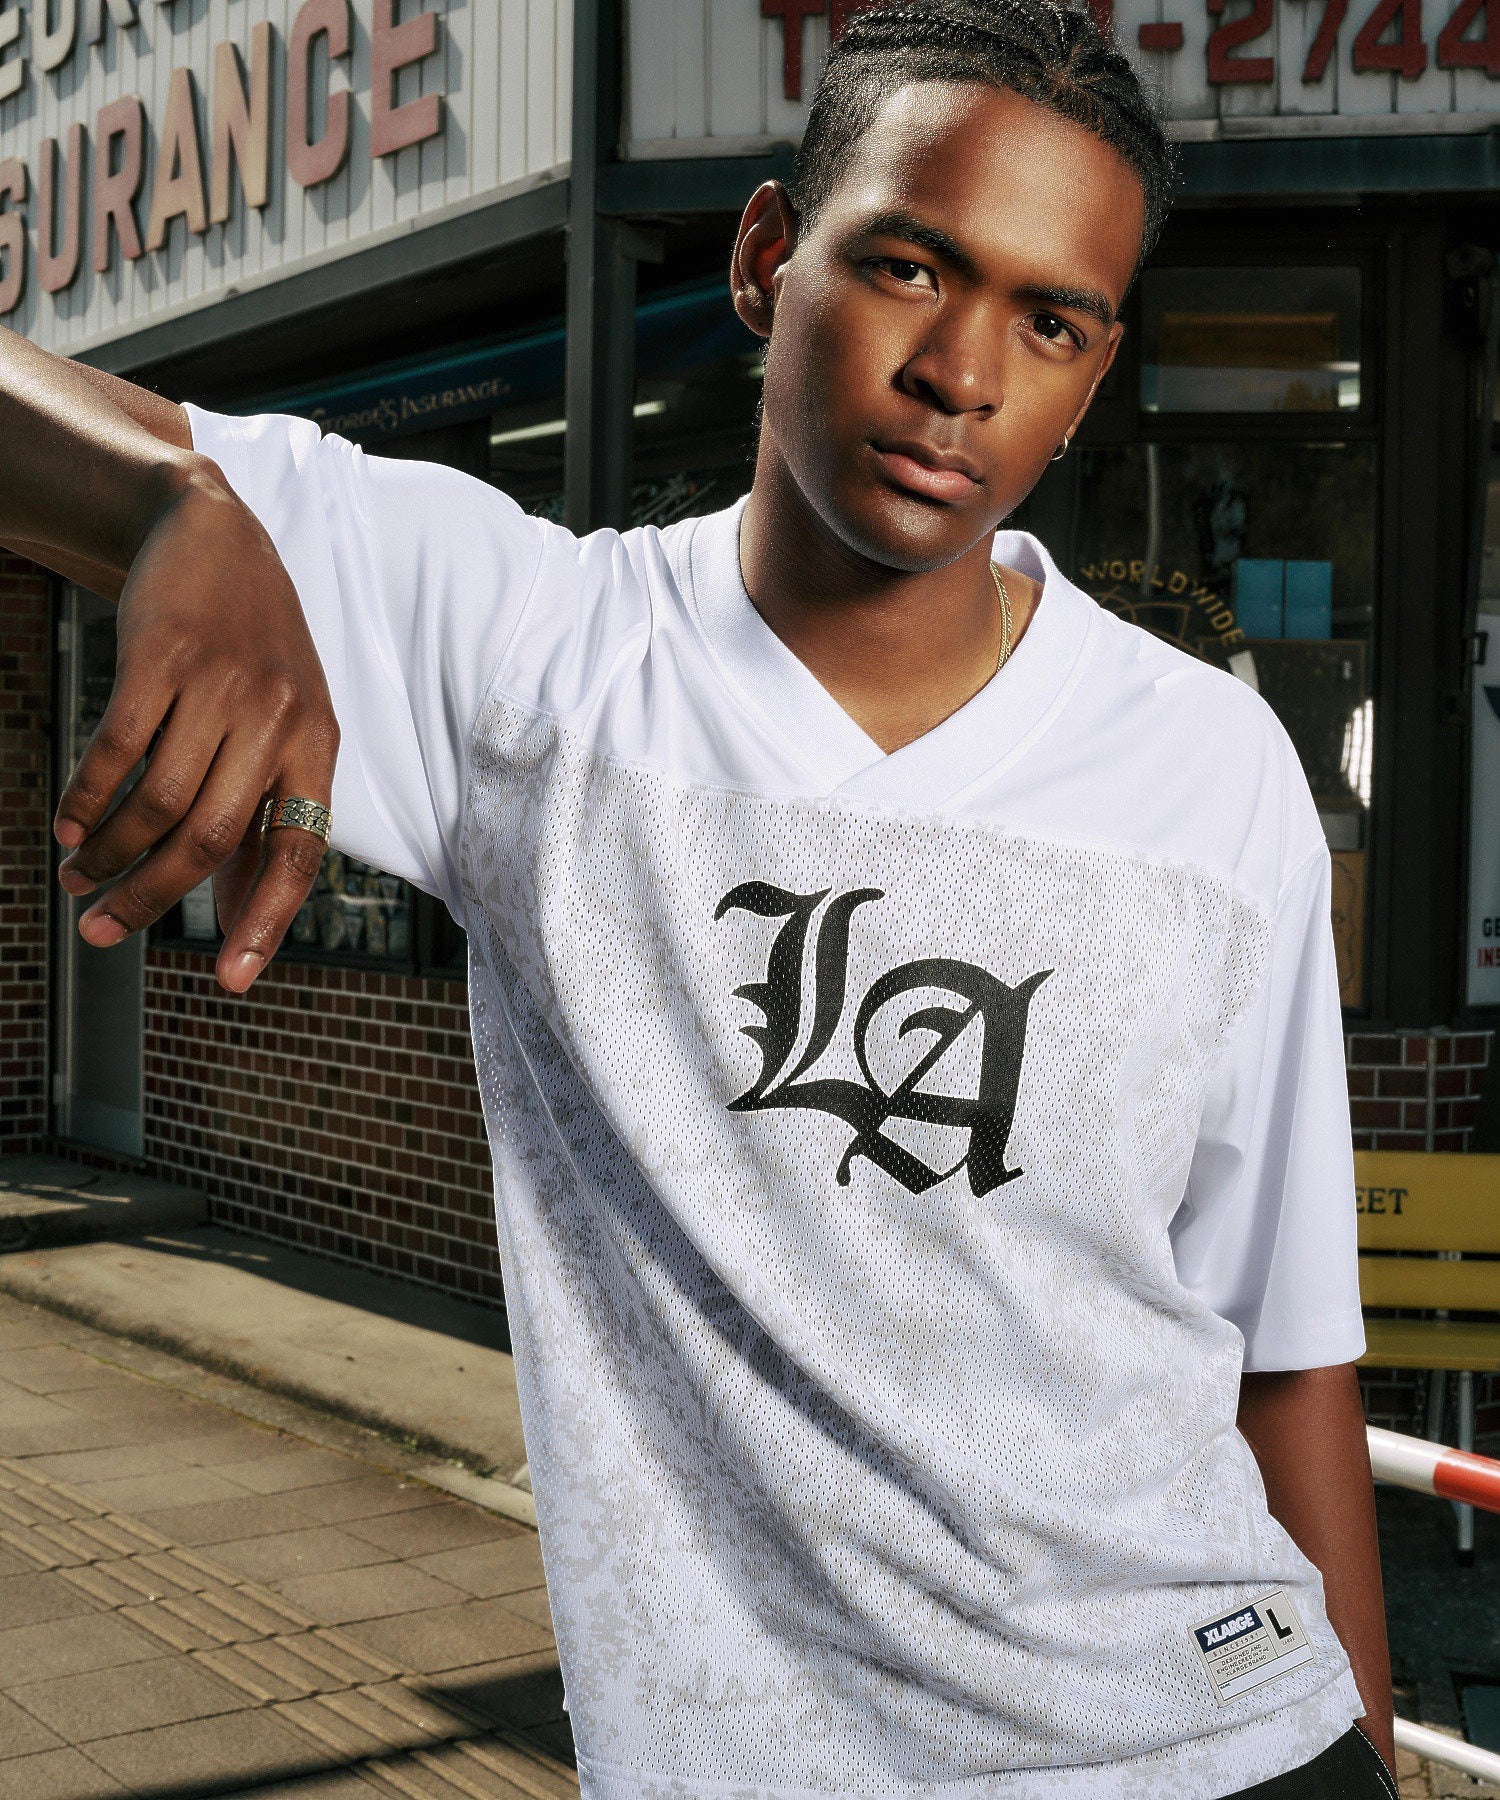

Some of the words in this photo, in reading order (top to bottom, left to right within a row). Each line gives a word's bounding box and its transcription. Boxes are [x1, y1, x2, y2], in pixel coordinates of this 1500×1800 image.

[1080, 559, 1246, 646] WORLDWIDE
[1203, 1612, 1255, 1646] XLARGE
[1265, 1608, 1293, 1640] L
[1221, 1650, 1250, 1666] DESIGNED
[1250, 1644, 1262, 1653] AND
[1225, 1663, 1249, 1678] XLARGE
[1248, 1654, 1267, 1667] BRAND
